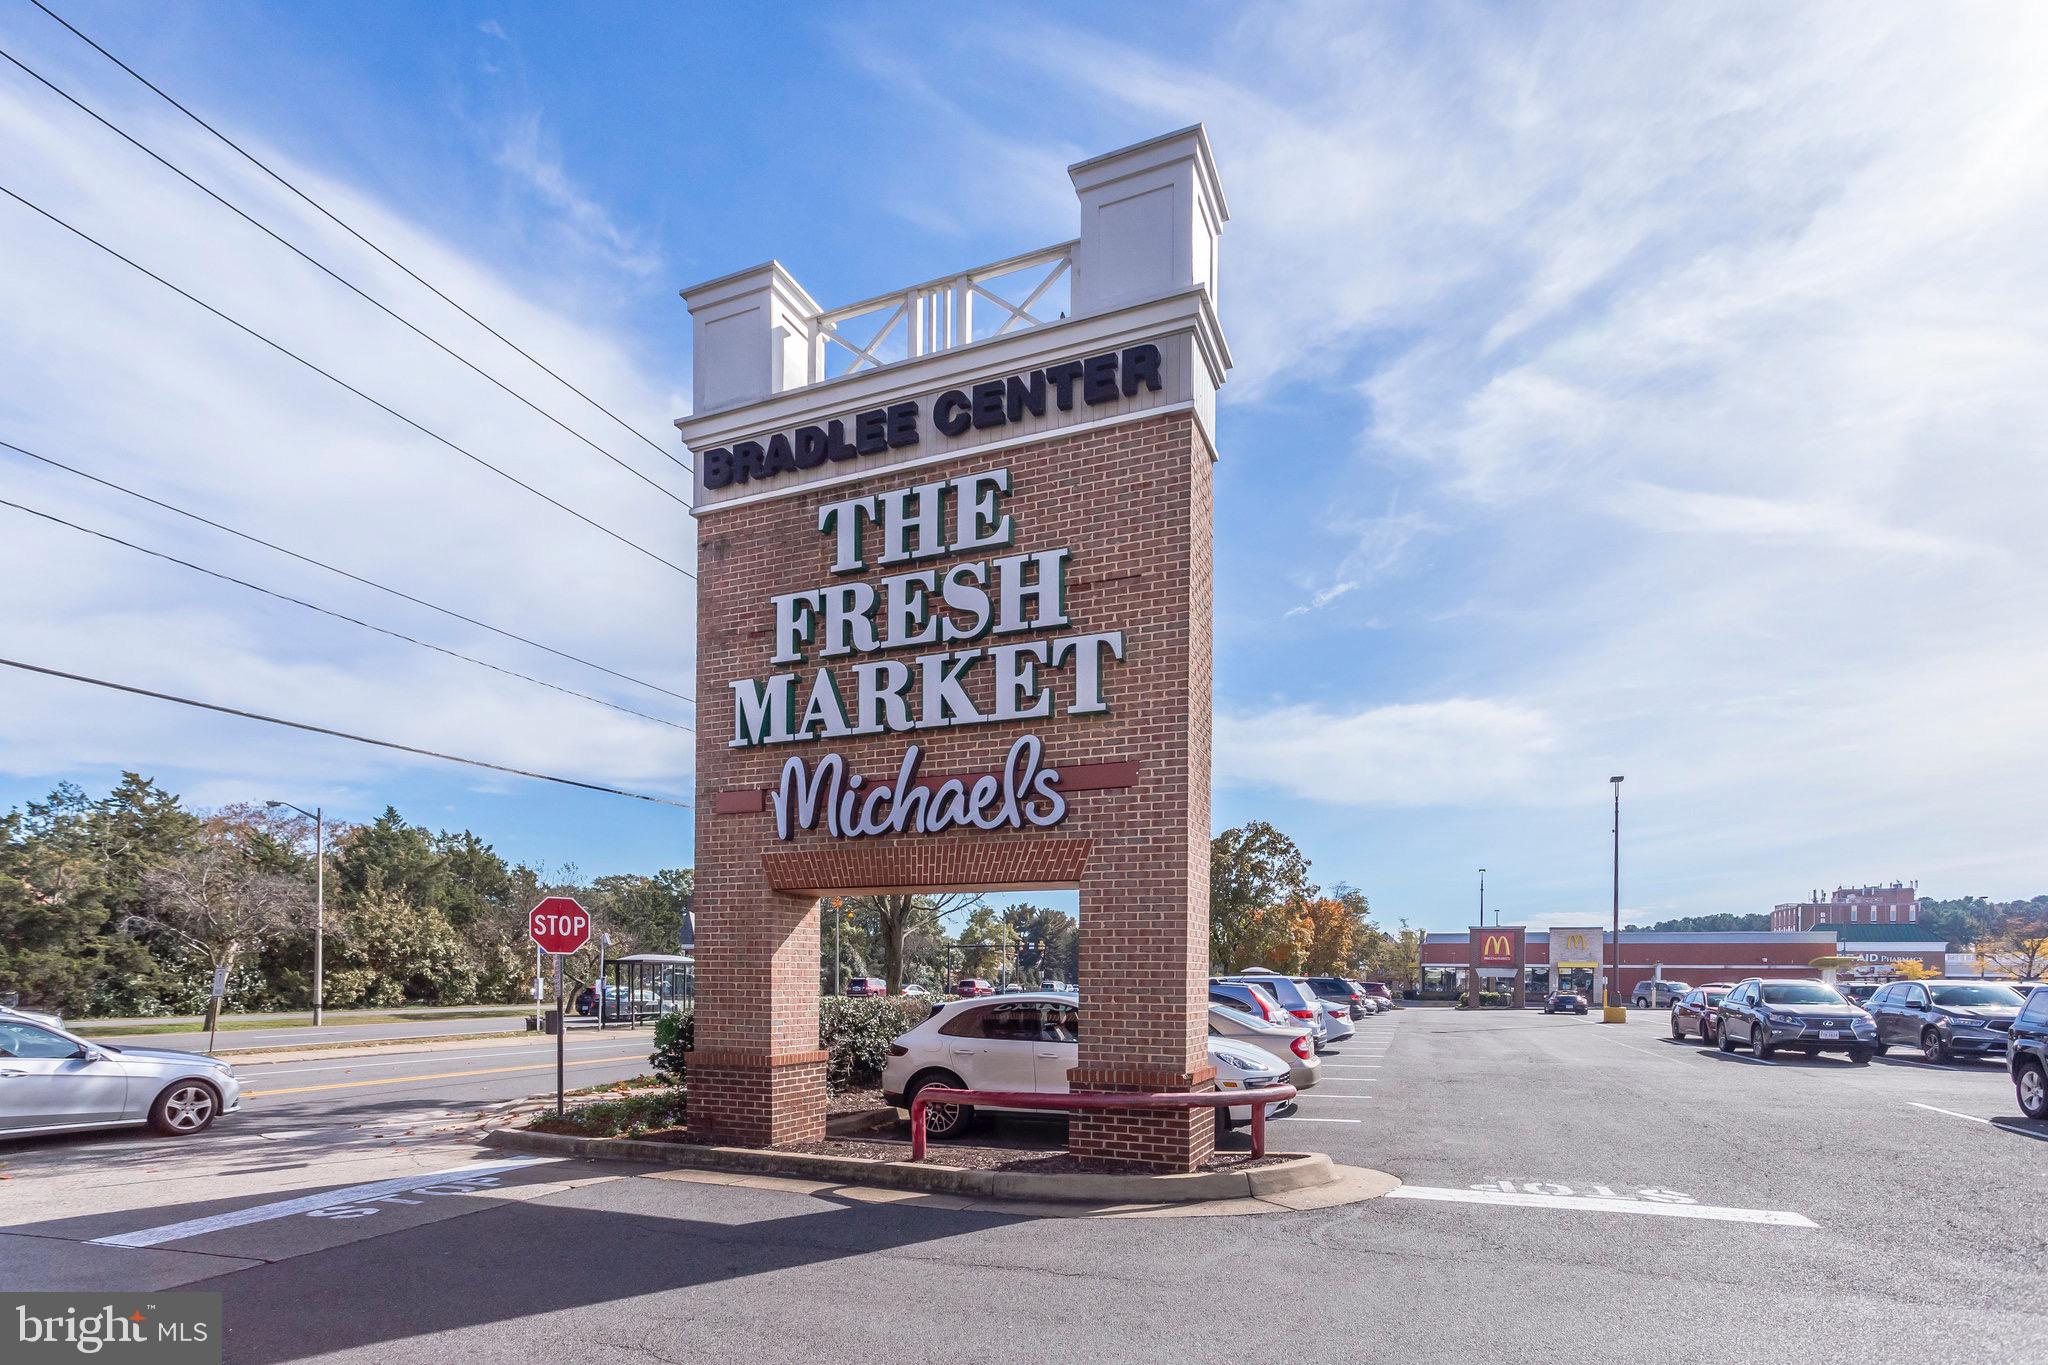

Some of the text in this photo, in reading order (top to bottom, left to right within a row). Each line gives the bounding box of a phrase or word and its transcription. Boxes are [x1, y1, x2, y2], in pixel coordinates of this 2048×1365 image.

[703, 344, 1162, 490] BRADLEE CENTER
[819, 468, 1013, 574] THE
[770, 548, 1071, 665] FRESH
[728, 631, 1125, 749] MARKET
[771, 733, 1069, 841] Michaels
[534, 914, 586, 937] STOP
[1857, 953, 1879, 962] AID
[306, 1177, 501, 1220] STOP
[1469, 1180, 1698, 1204] STOP
